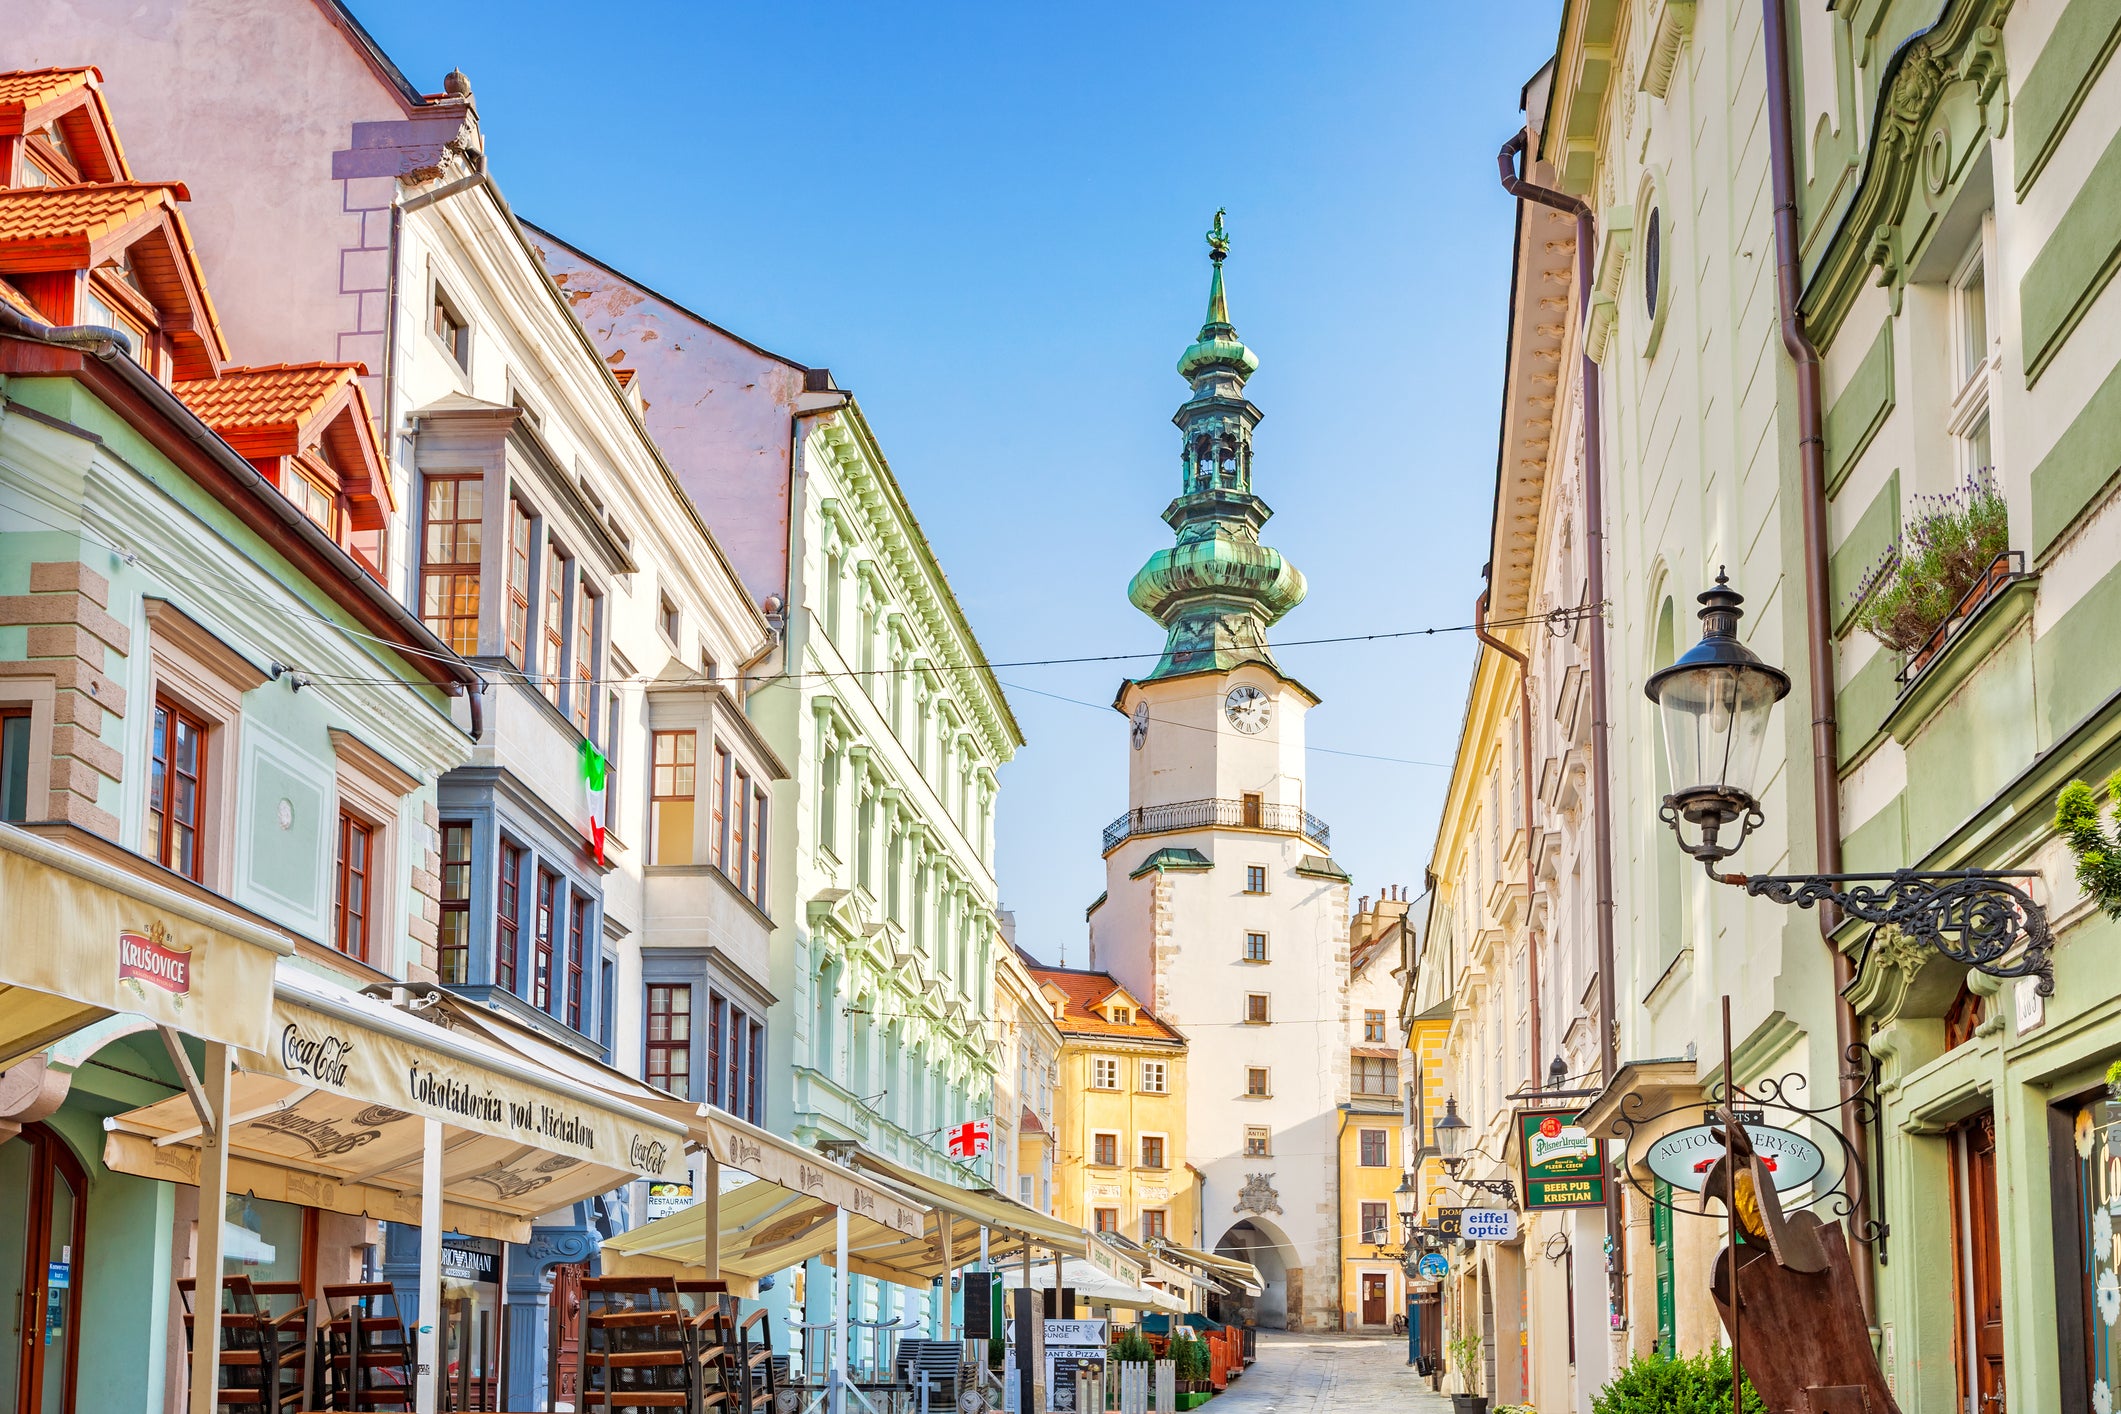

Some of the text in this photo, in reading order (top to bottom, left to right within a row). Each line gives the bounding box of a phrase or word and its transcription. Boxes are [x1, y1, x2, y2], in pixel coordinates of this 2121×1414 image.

[122, 940, 185, 984] KRUŠOVICE
[282, 1023, 355, 1087] Coca-Cola
[410, 1059, 594, 1149] Čokoládovňa pod Michalom
[1536, 1136, 1588, 1156] Pilsner Urquell
[1544, 1182, 1590, 1192] BEER PUB
[649, 1197, 692, 1205] RESTAURANT
[1544, 1192, 1591, 1203] KRISTIAN
[1470, 1213, 1508, 1224] eiffel
[1468, 1225, 1508, 1237] optic
[462, 1251, 491, 1272] ARMANI
